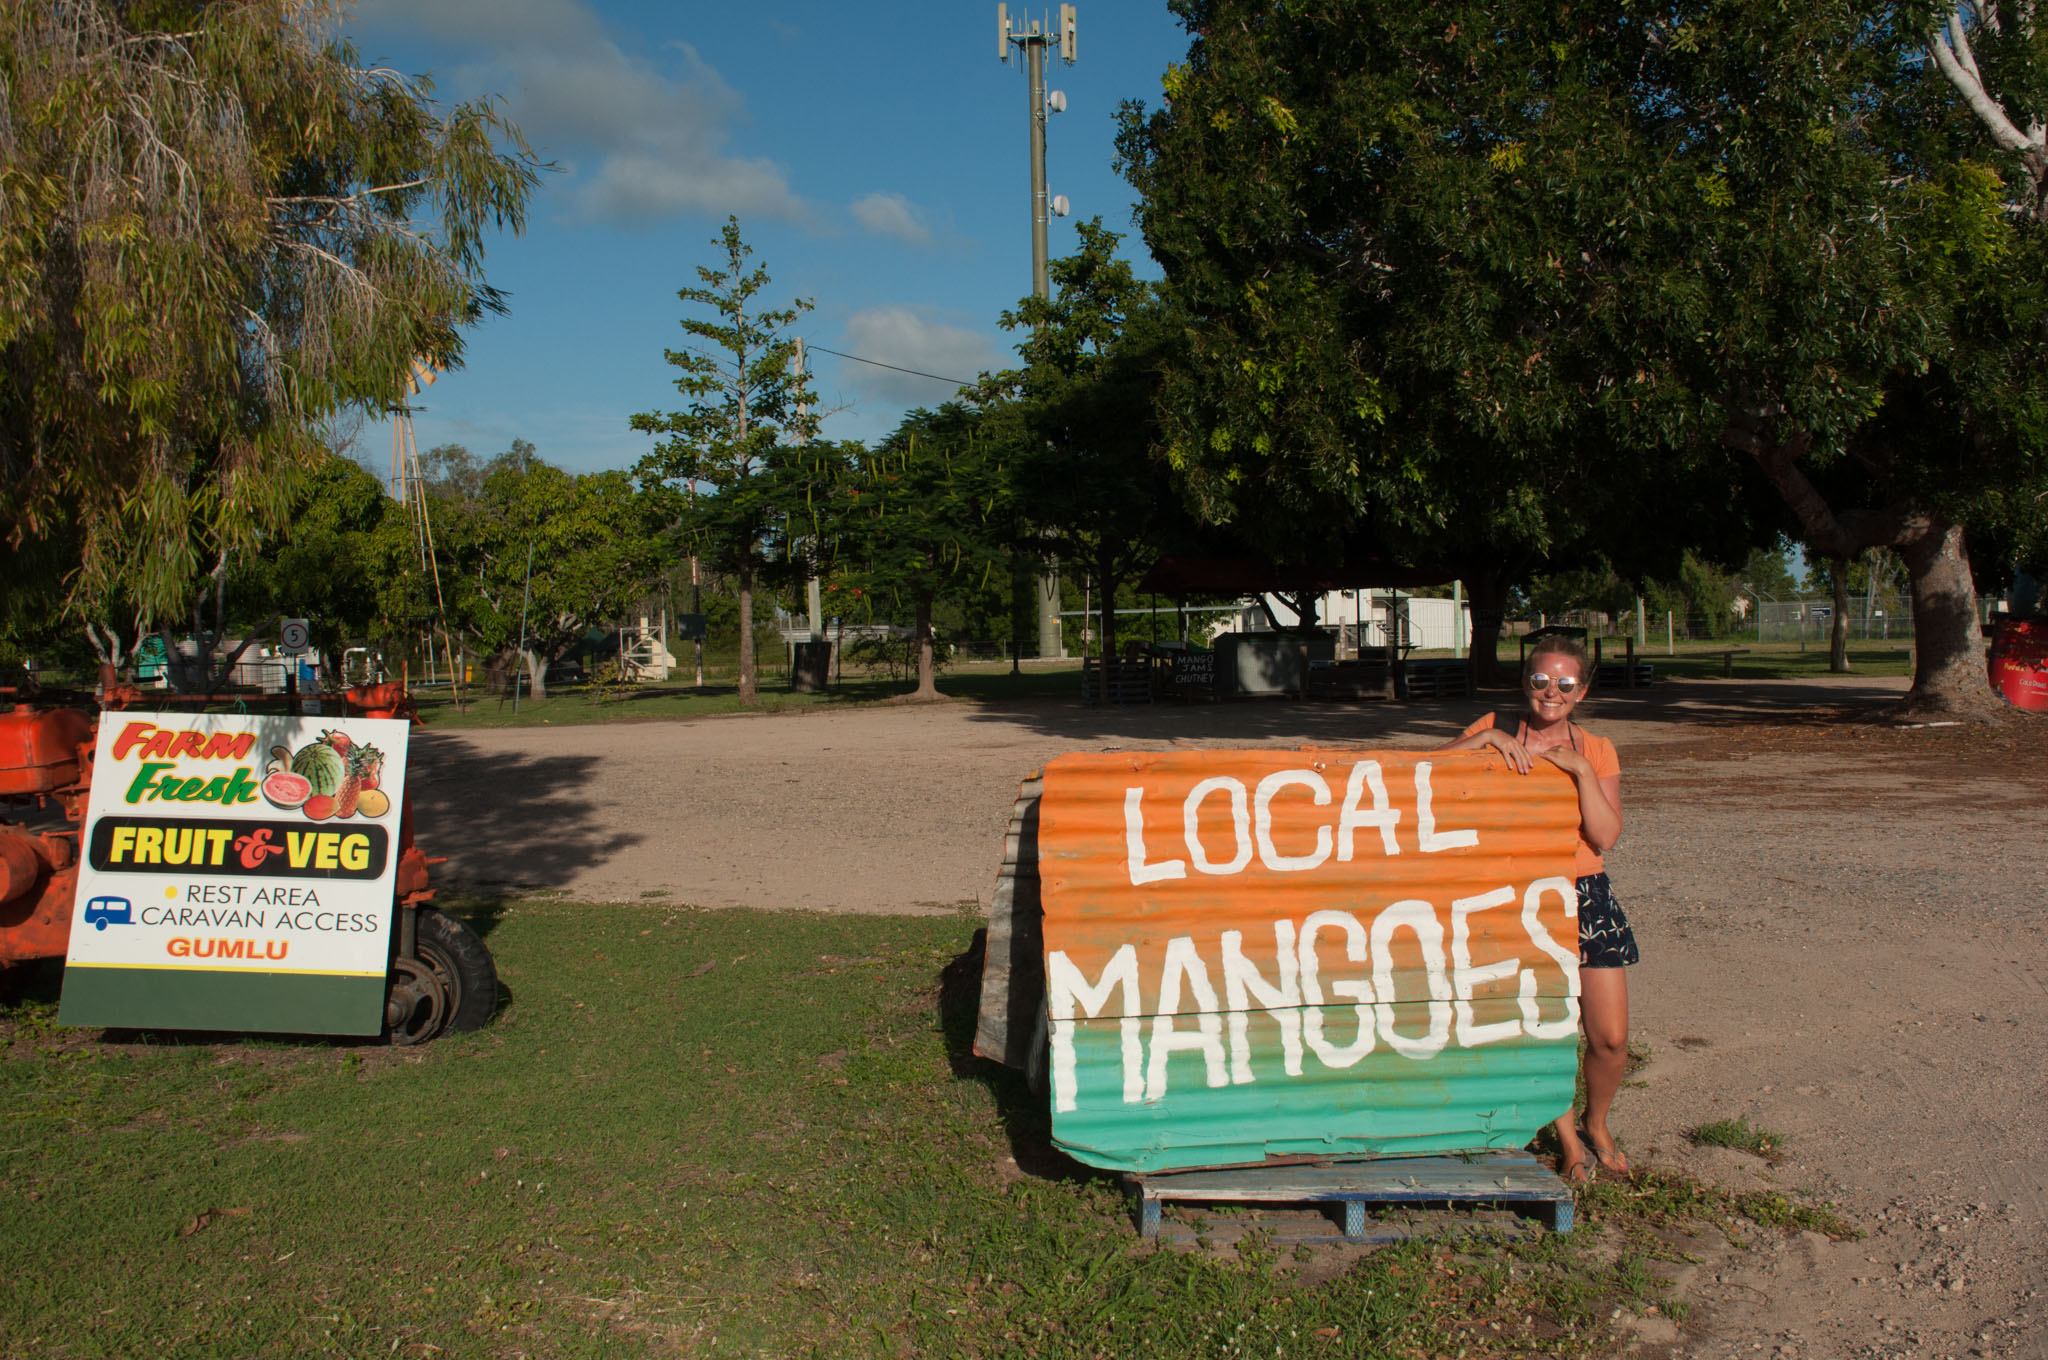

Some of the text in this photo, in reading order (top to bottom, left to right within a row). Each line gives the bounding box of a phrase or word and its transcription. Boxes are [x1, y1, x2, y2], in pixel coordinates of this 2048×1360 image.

[291, 630, 299, 642] 5
[1177, 655, 1214, 665] MANGO
[1175, 673, 1215, 683] CHUTNEY
[125, 762, 260, 806] Fresh
[1124, 760, 1479, 885] LOCAL
[110, 827, 370, 870] FRUIT & VEG
[187, 885, 320, 906] REST AREA
[141, 907, 378, 932] CARAVAN ACCESS
[166, 937, 290, 960] GUMLU
[1048, 876, 1581, 1113] MANGOES
